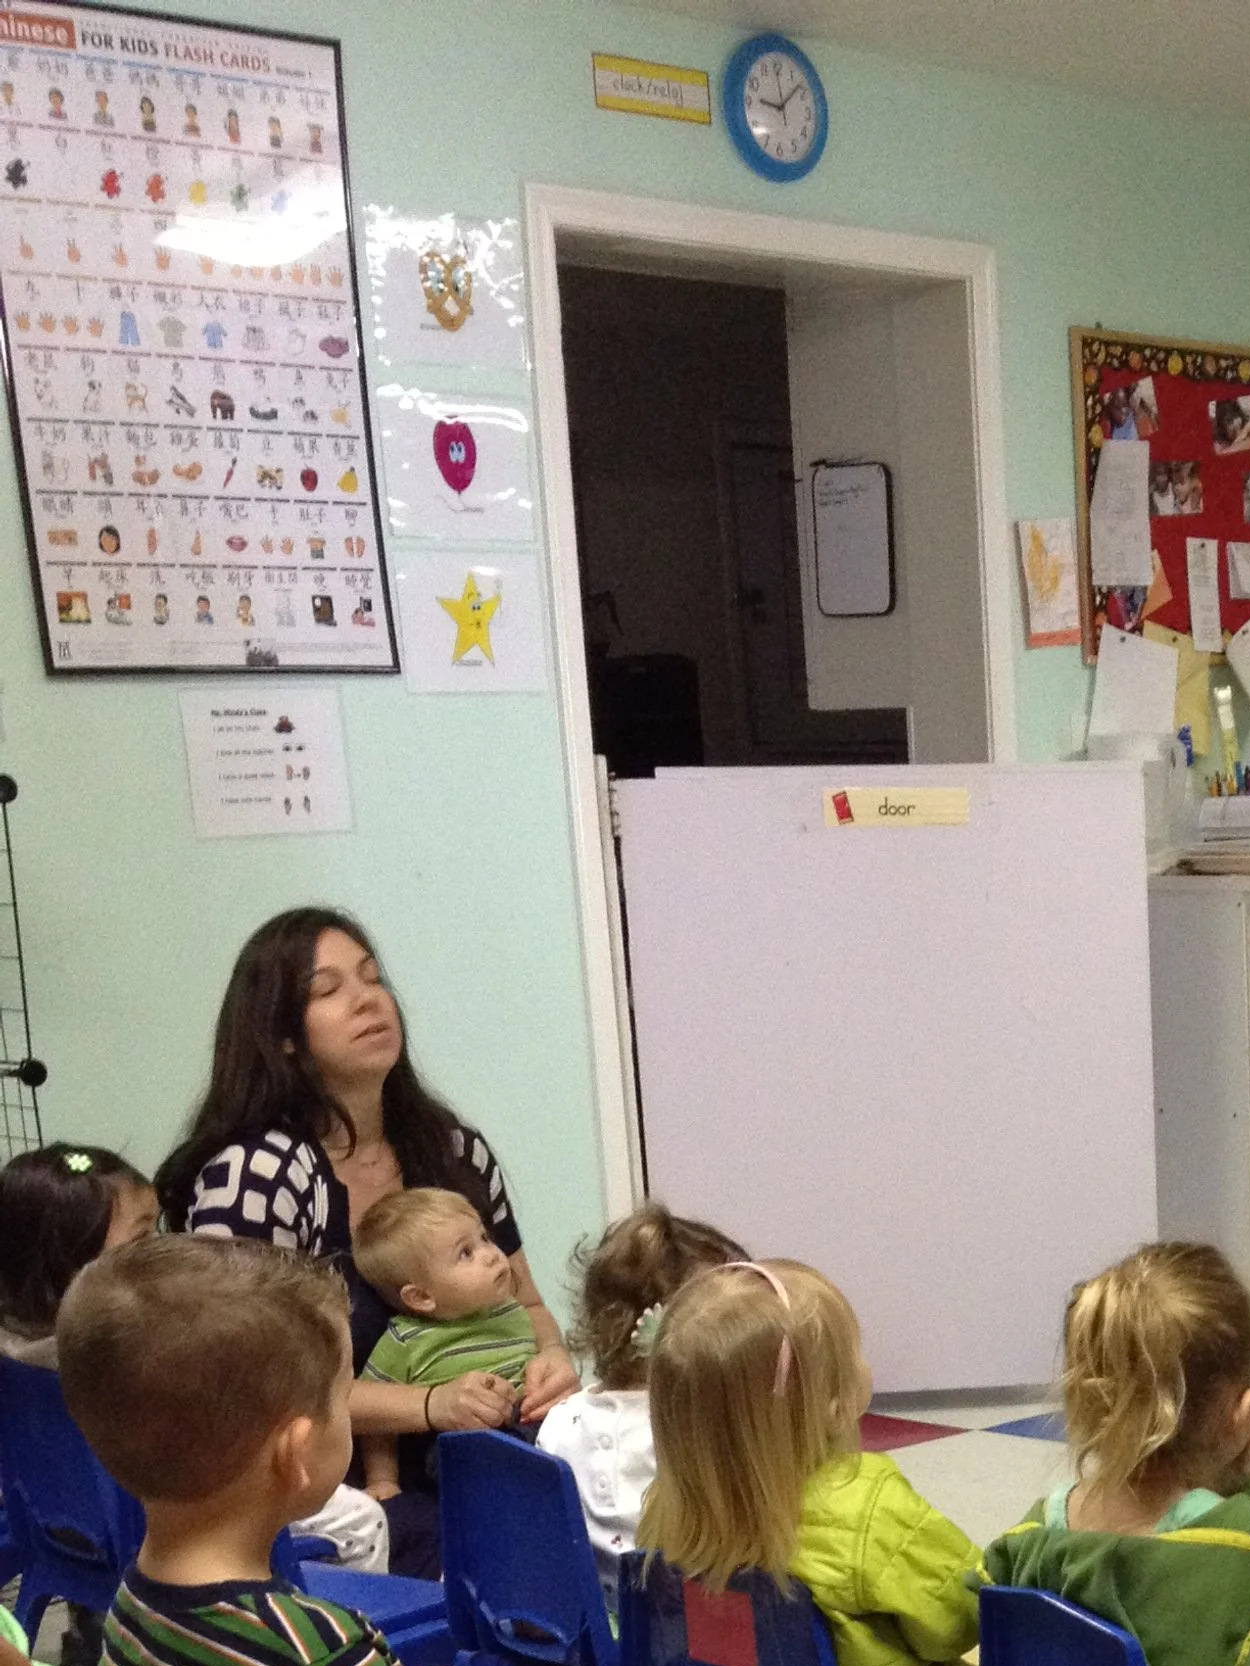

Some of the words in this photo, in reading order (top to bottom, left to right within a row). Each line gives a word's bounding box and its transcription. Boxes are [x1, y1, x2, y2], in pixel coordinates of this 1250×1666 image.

[81, 29, 115, 50] FOR
[120, 35, 159, 56] KIDS
[164, 41, 215, 65] FLASH
[219, 49, 271, 74] CARDS
[878, 796, 916, 816] door
